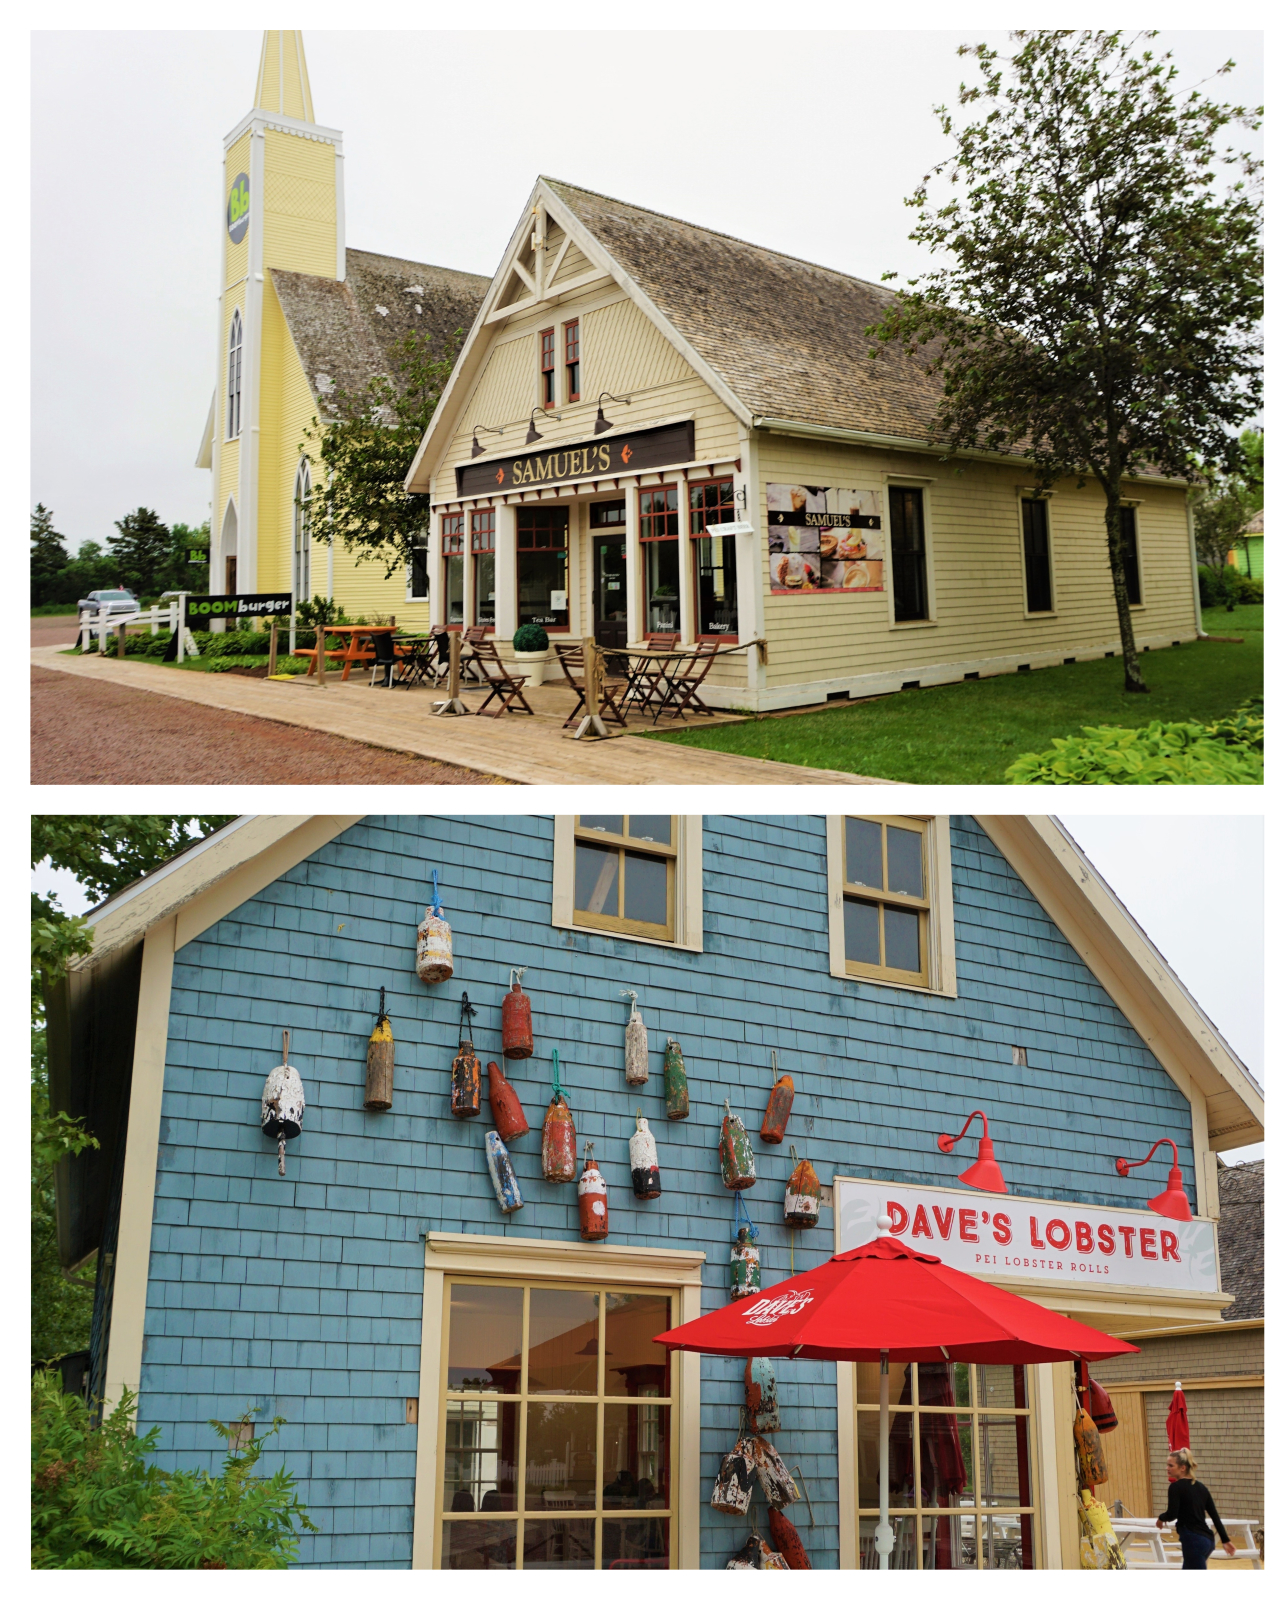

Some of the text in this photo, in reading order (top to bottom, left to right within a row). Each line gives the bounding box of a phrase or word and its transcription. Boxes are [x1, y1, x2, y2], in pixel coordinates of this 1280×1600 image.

[512, 444, 610, 485] SAMUEL'S
[805, 513, 850, 527] SAMUEL'S
[190, 550, 207, 560] Bb
[709, 622, 730, 631] Bakery
[886, 1200, 1182, 1263] DAVE'S LOBSTER
[976, 1254, 1110, 1274] PEI LOBSTER ROLLS
